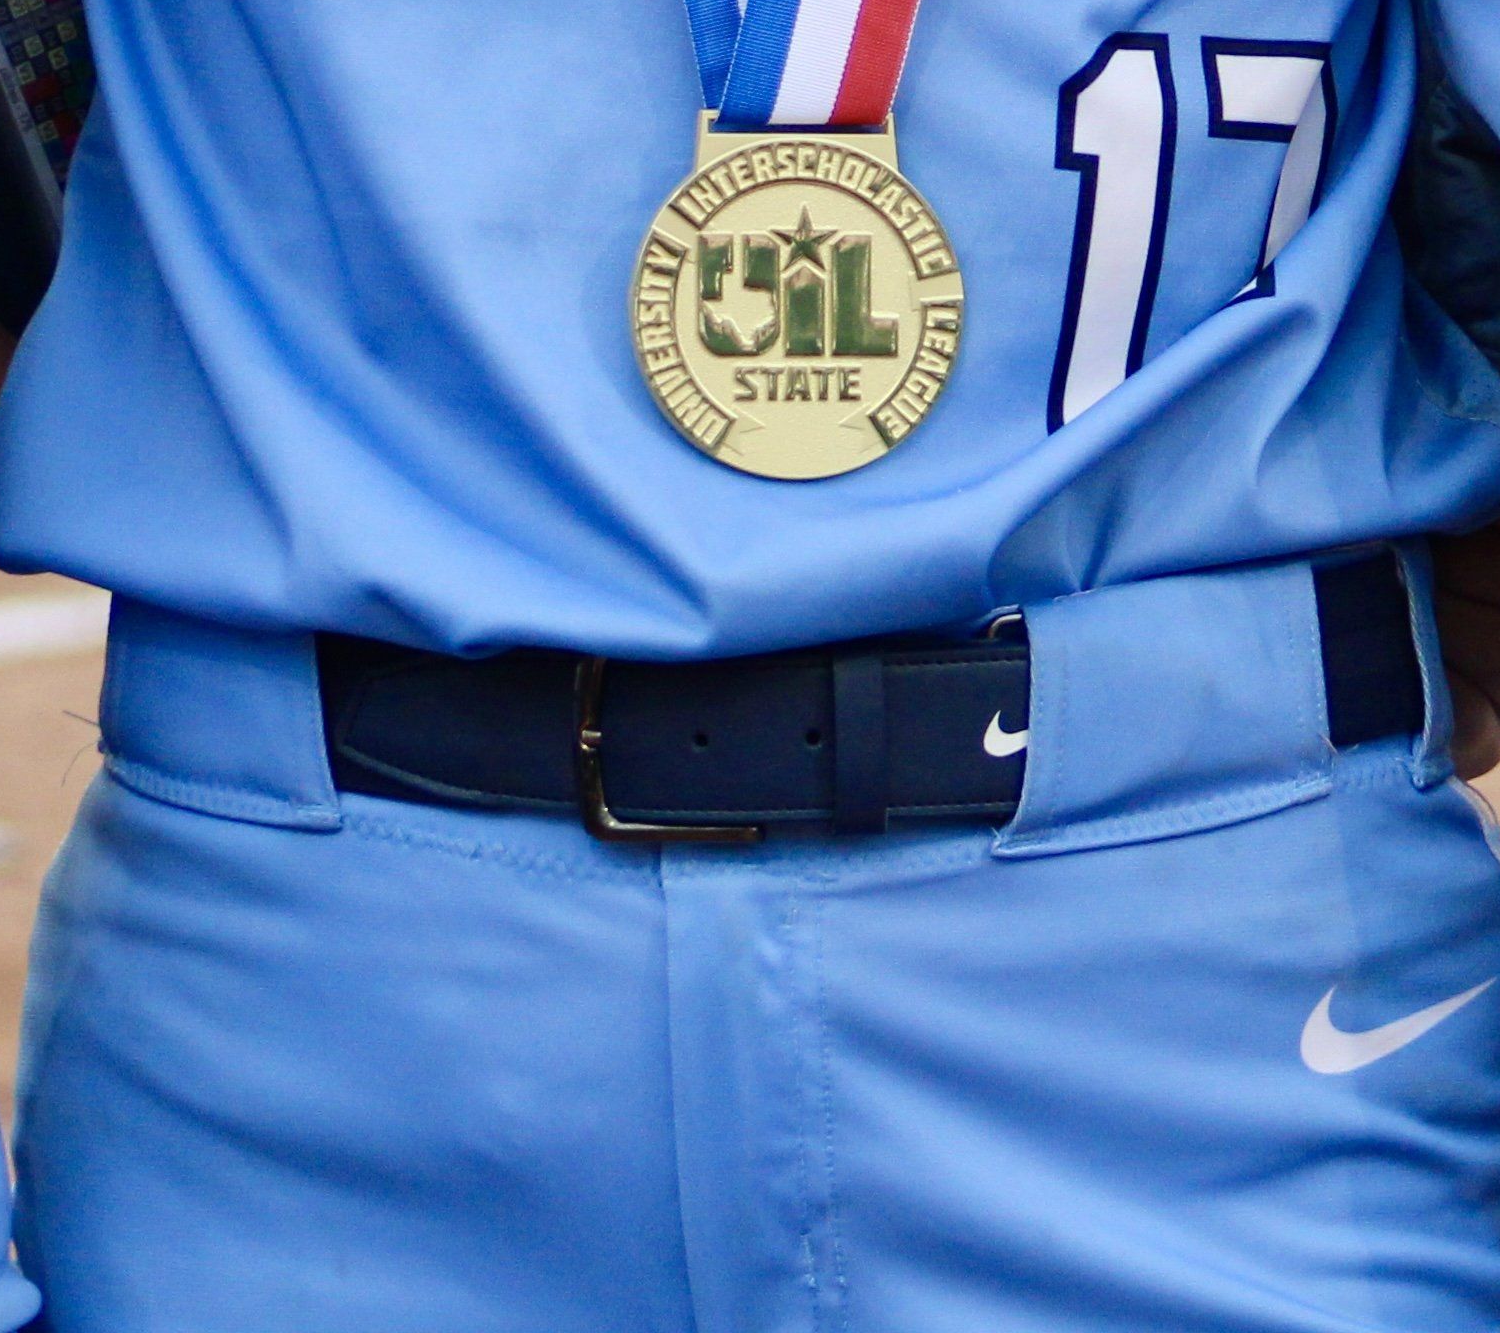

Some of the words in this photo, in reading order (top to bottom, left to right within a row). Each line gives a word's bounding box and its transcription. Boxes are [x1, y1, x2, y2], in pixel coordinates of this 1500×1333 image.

[675, 144, 949, 277] INTERSCHOLASTIC
[1047, 31, 1338, 437] 17
[639, 243, 726, 443] UNIVERSITY
[734, 366, 861, 401] STATE
[878, 302, 959, 440] LEAGUE
